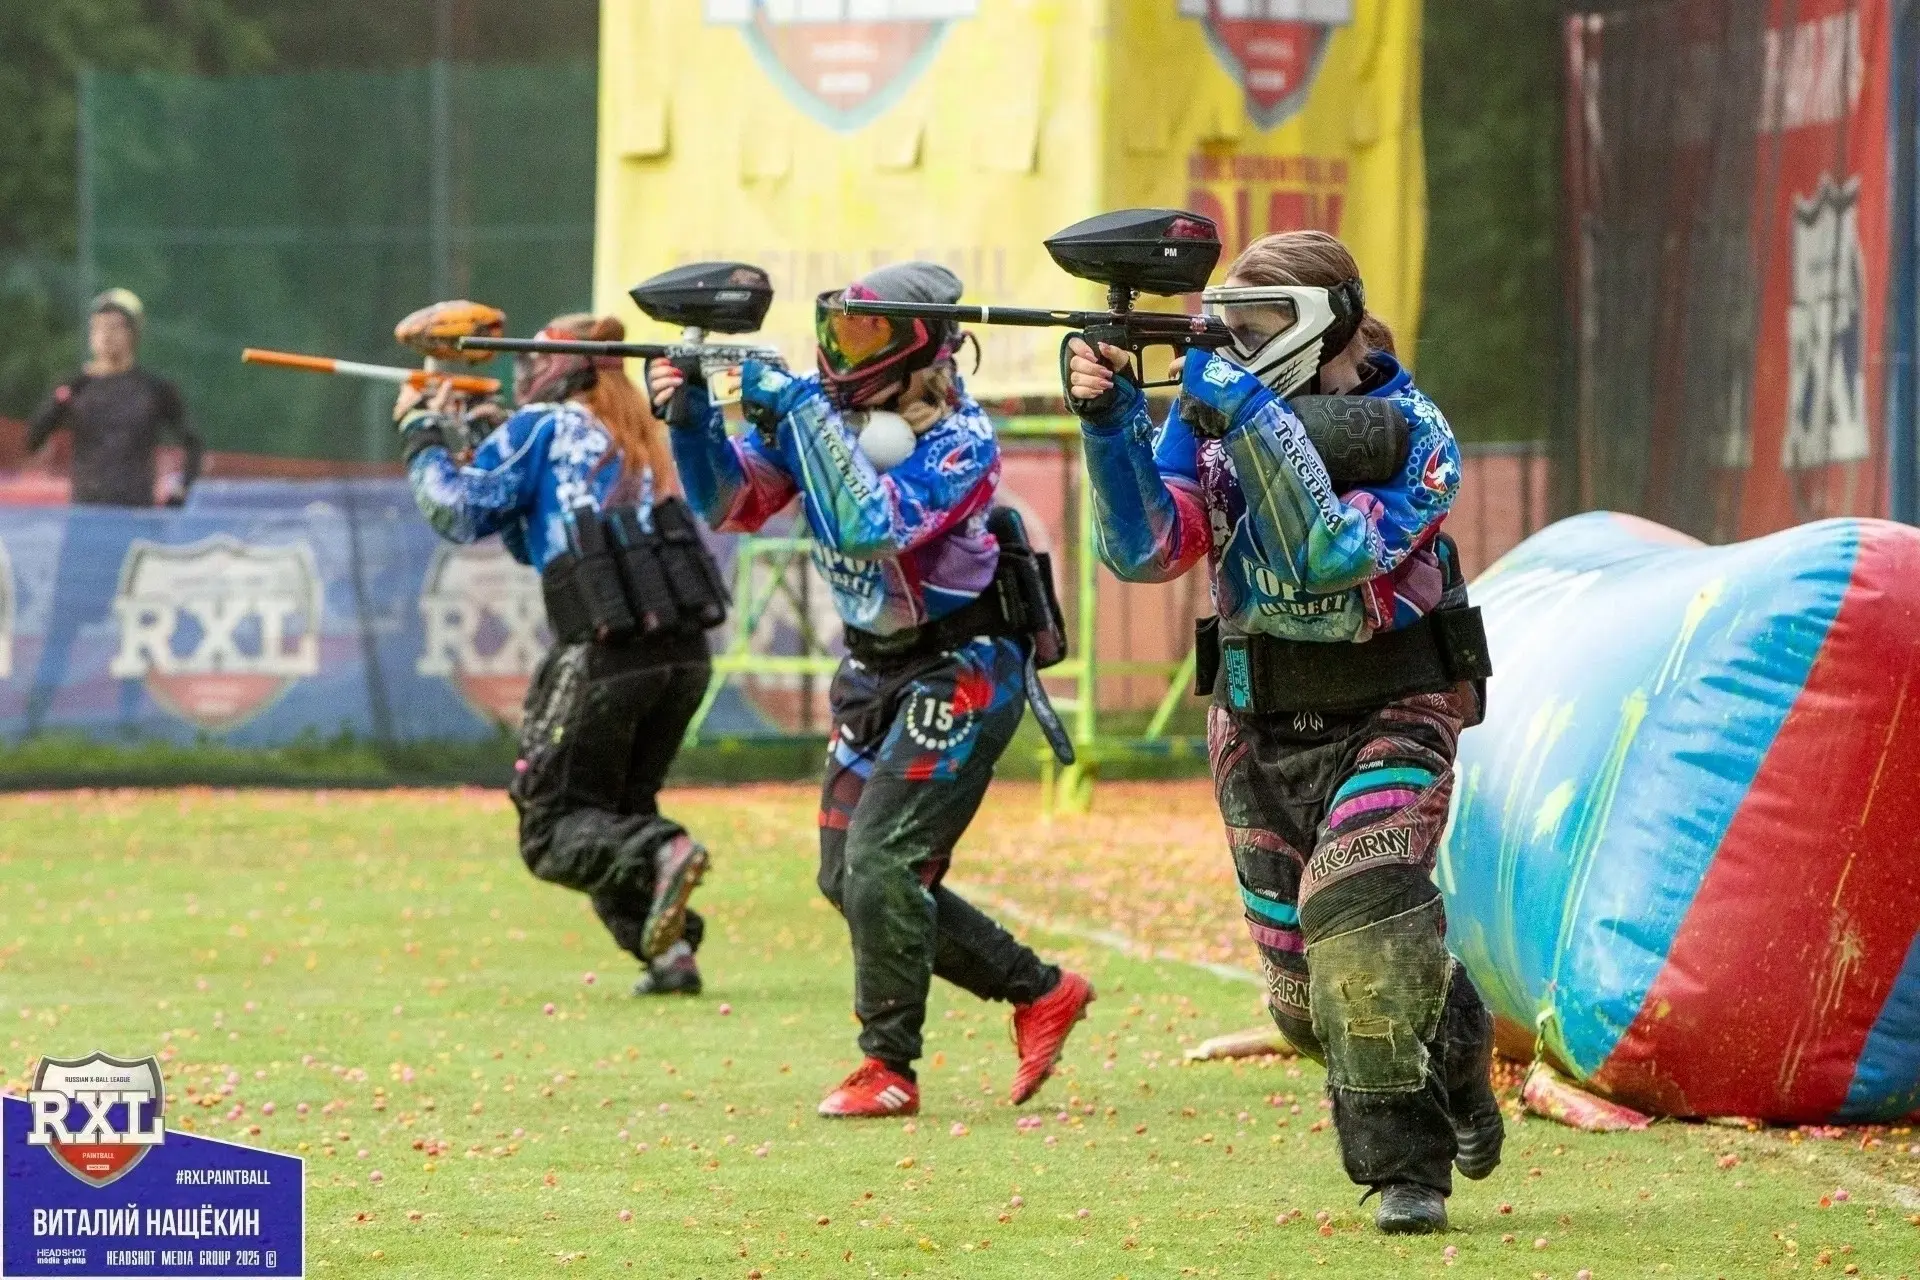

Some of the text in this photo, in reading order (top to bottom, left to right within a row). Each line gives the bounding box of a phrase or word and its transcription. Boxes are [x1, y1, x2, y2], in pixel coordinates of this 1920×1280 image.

[1164, 247, 1178, 257] PM
[110, 600, 318, 678] RXL
[416, 600, 553, 677] RX
[922, 697, 954, 732] 15
